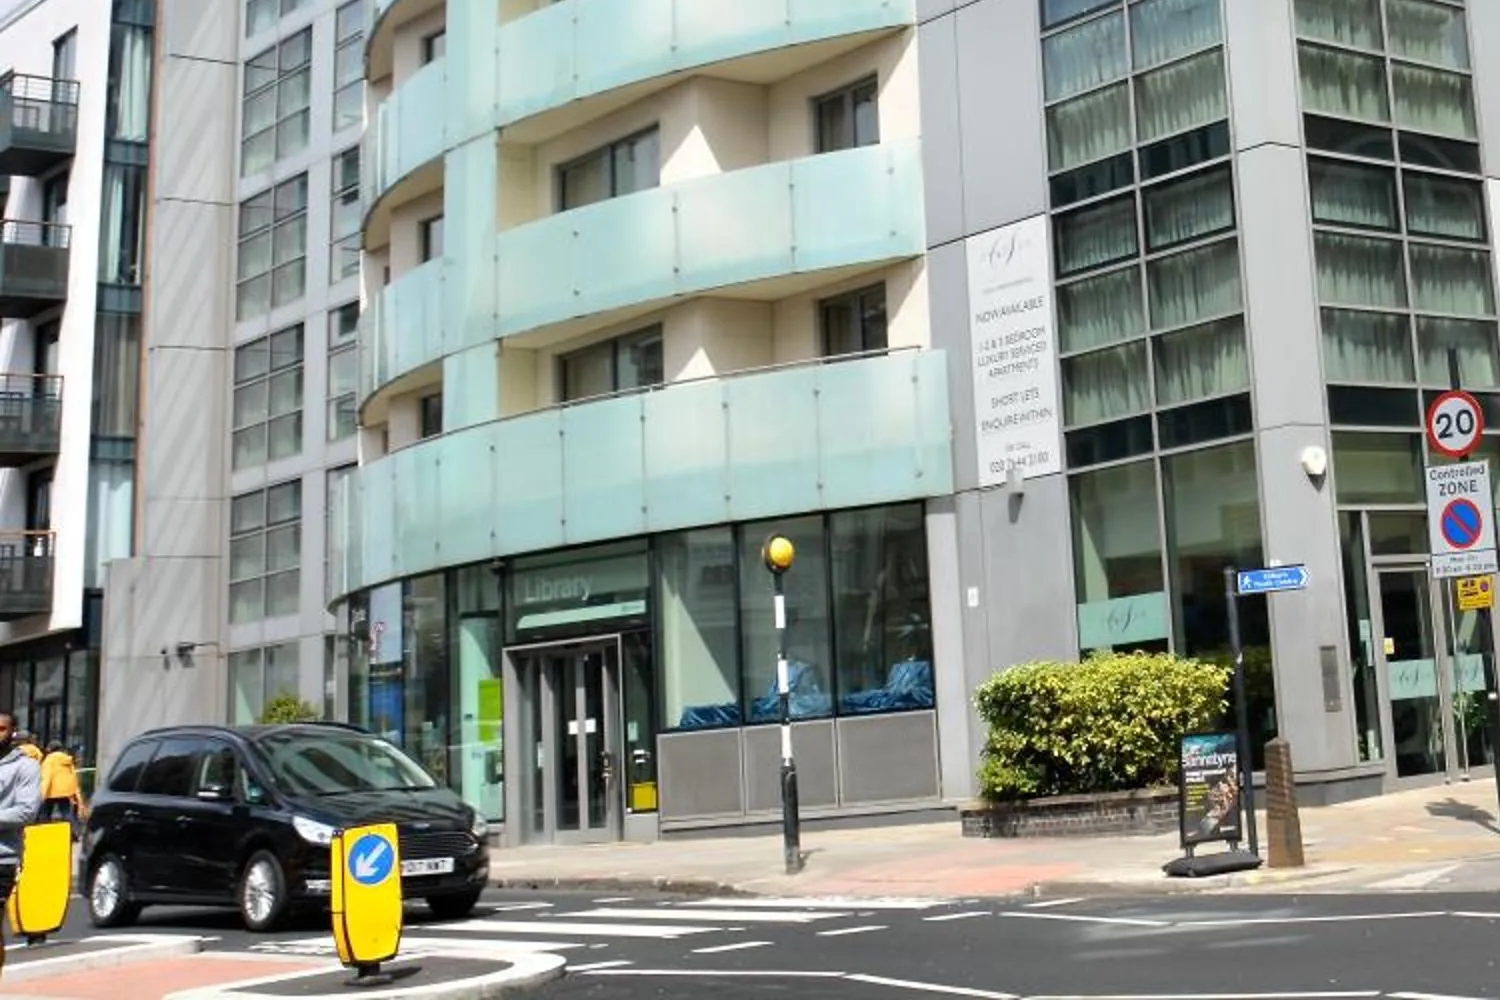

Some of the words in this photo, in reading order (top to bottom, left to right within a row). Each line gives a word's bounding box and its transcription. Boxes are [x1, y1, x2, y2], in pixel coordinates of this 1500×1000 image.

[1436, 409, 1475, 439] 20
[1429, 464, 1485, 481] Controlled
[1439, 480, 1478, 497] ZONE
[525, 574, 594, 602] Library
